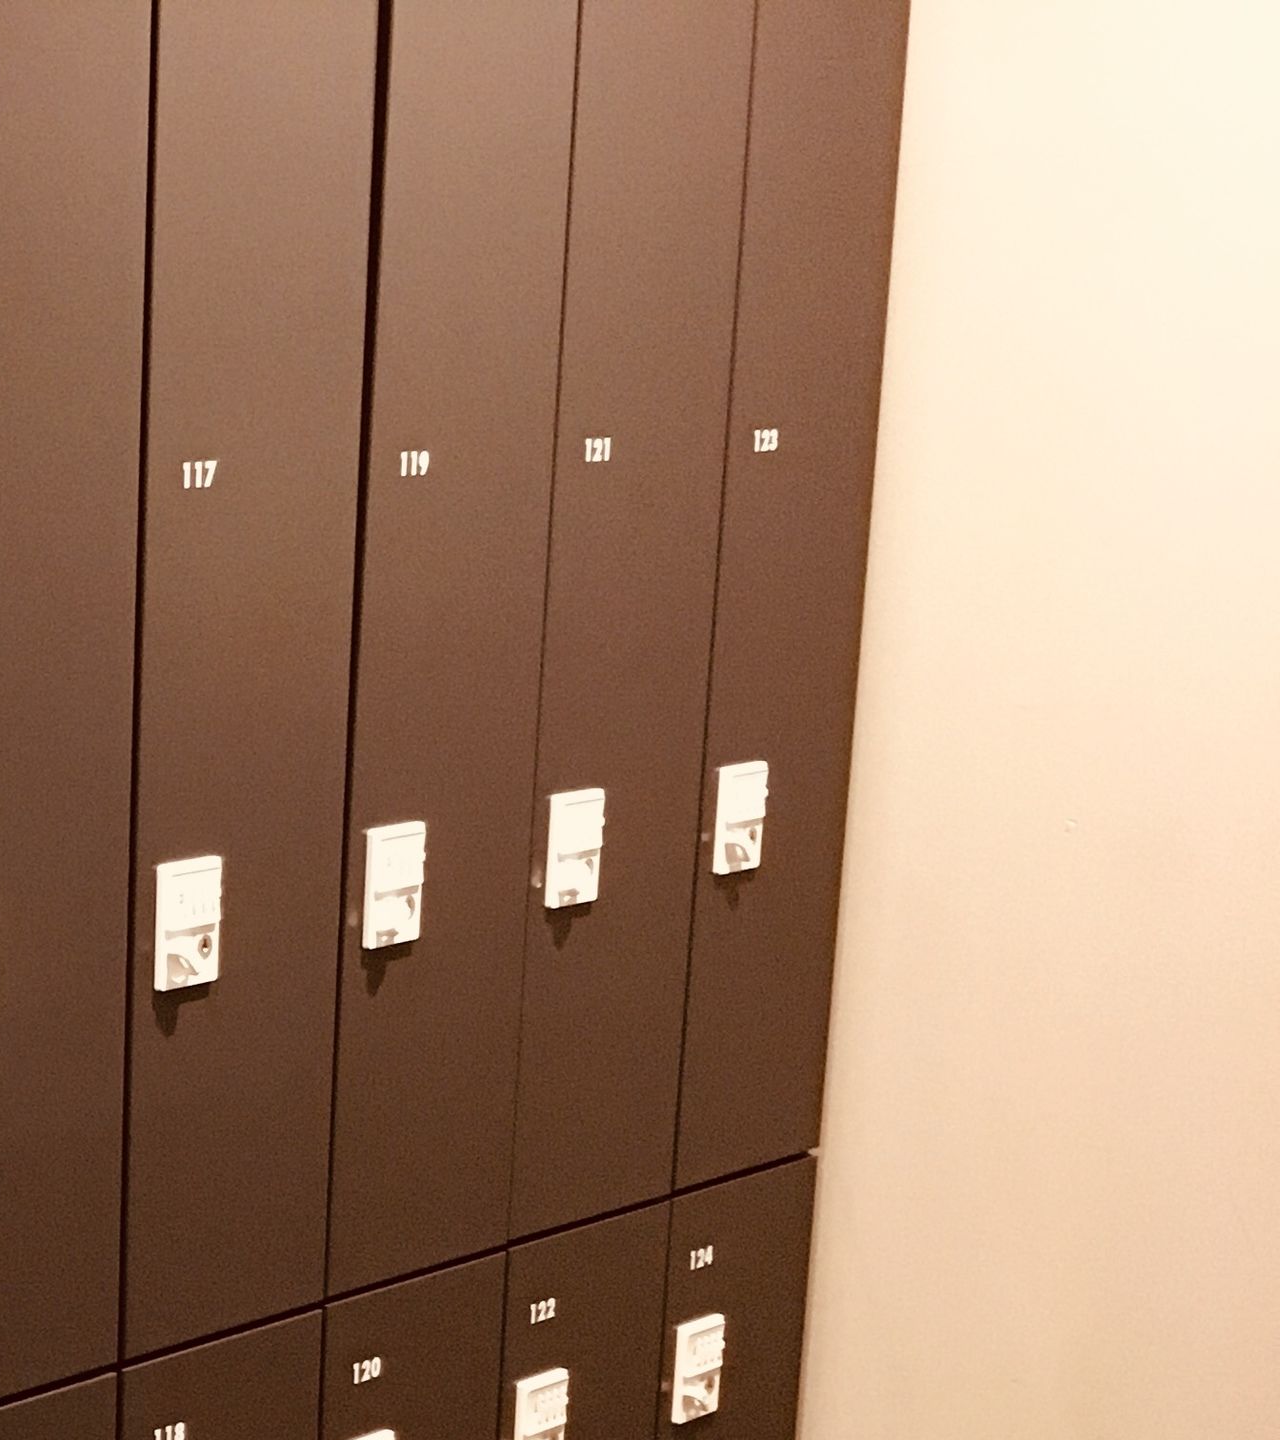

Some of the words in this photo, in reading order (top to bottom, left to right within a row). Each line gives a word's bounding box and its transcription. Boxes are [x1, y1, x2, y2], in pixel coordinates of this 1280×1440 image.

[585, 438, 611, 462] 121
[754, 429, 778, 452] 123
[183, 461, 217, 488] 117
[401, 451, 429, 476] 119
[691, 1246, 713, 1270] 124
[531, 1298, 555, 1324] 122
[353, 1357, 381, 1384] 120
